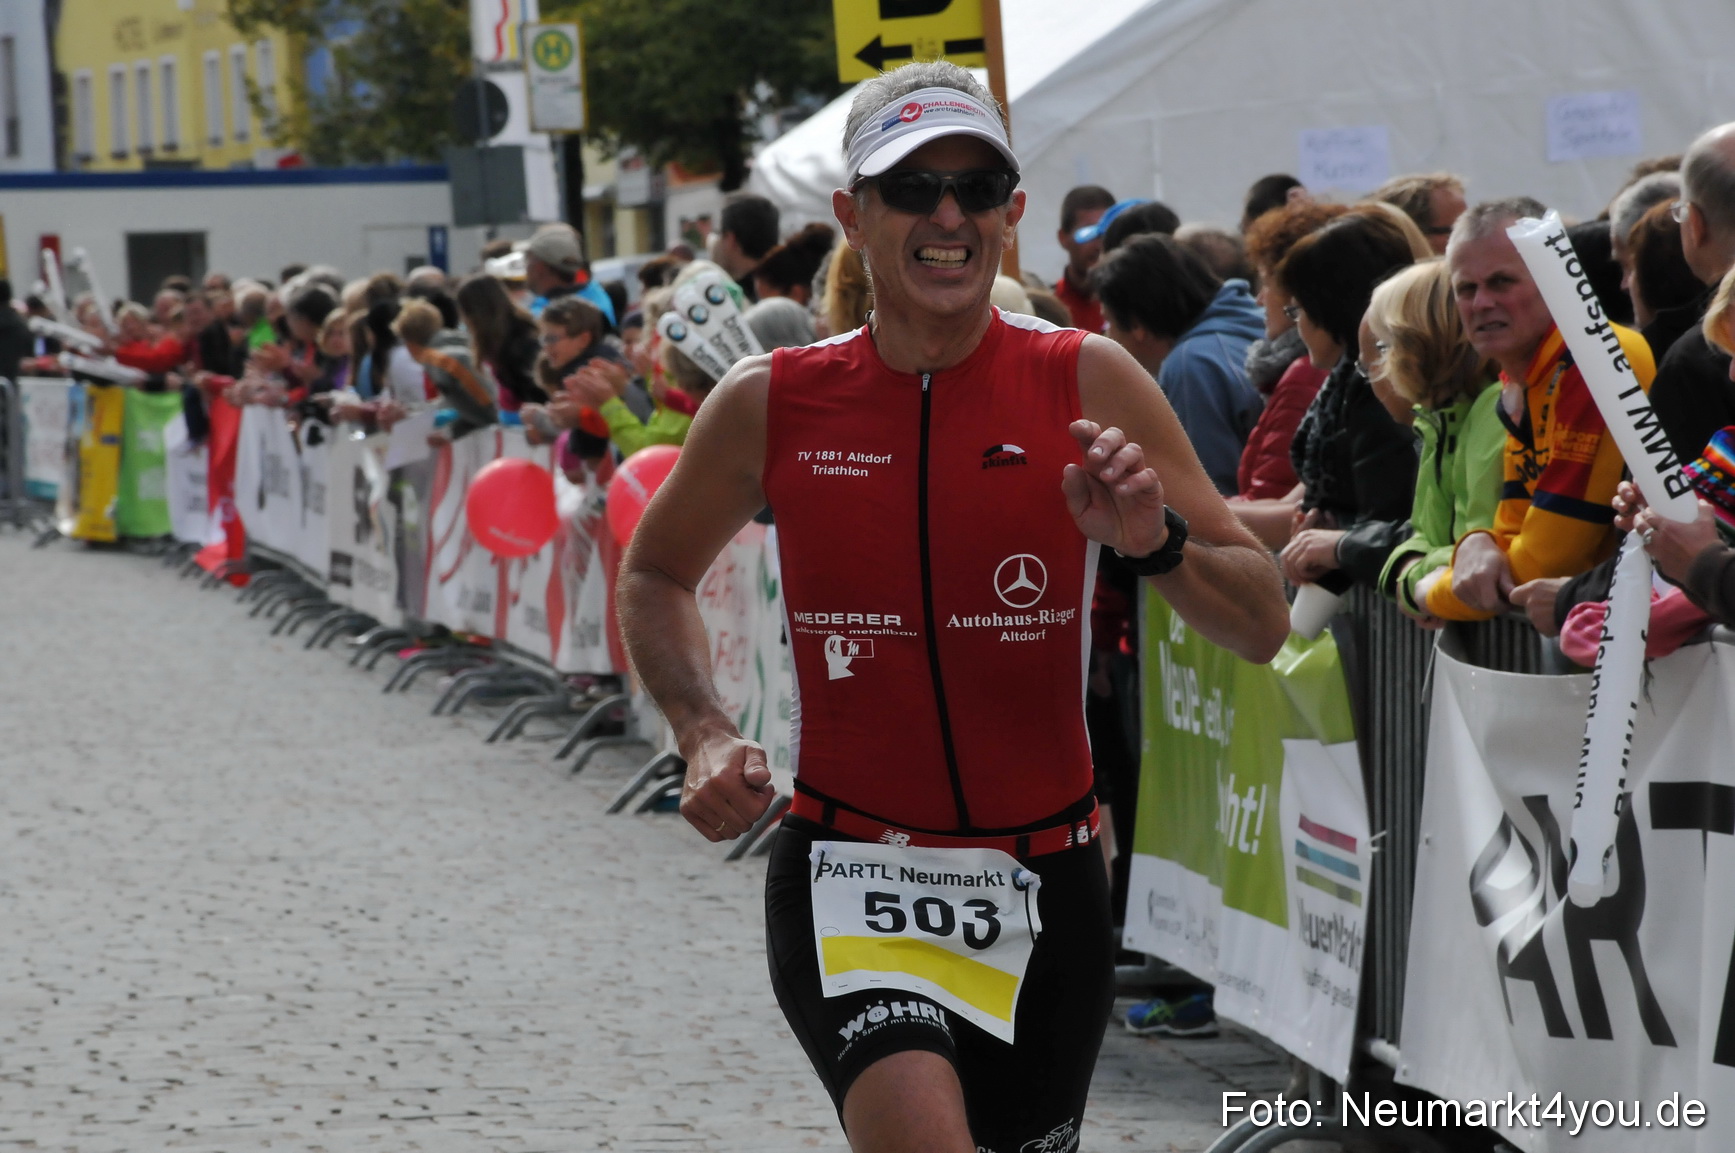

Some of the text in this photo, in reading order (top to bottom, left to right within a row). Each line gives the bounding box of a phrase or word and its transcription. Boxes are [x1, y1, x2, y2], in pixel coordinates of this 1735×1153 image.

[797, 450, 892, 464] TV 1881 Altdorf
[1626, 404, 1692, 500] BMW
[812, 464, 869, 477] Triathlon
[794, 611, 902, 626] MEDERER
[946, 607, 1076, 628] Autohaus-Rieger
[848, 628, 918, 637] metallbau
[1000, 629, 1046, 642] Altdorf
[818, 861, 1006, 888] PARTL Neumarkt
[864, 890, 1002, 950] 503
[838, 999, 950, 1041] WÖHRL
[862, 1021, 887, 1037] Sport
[890, 1017, 907, 1025] mit
